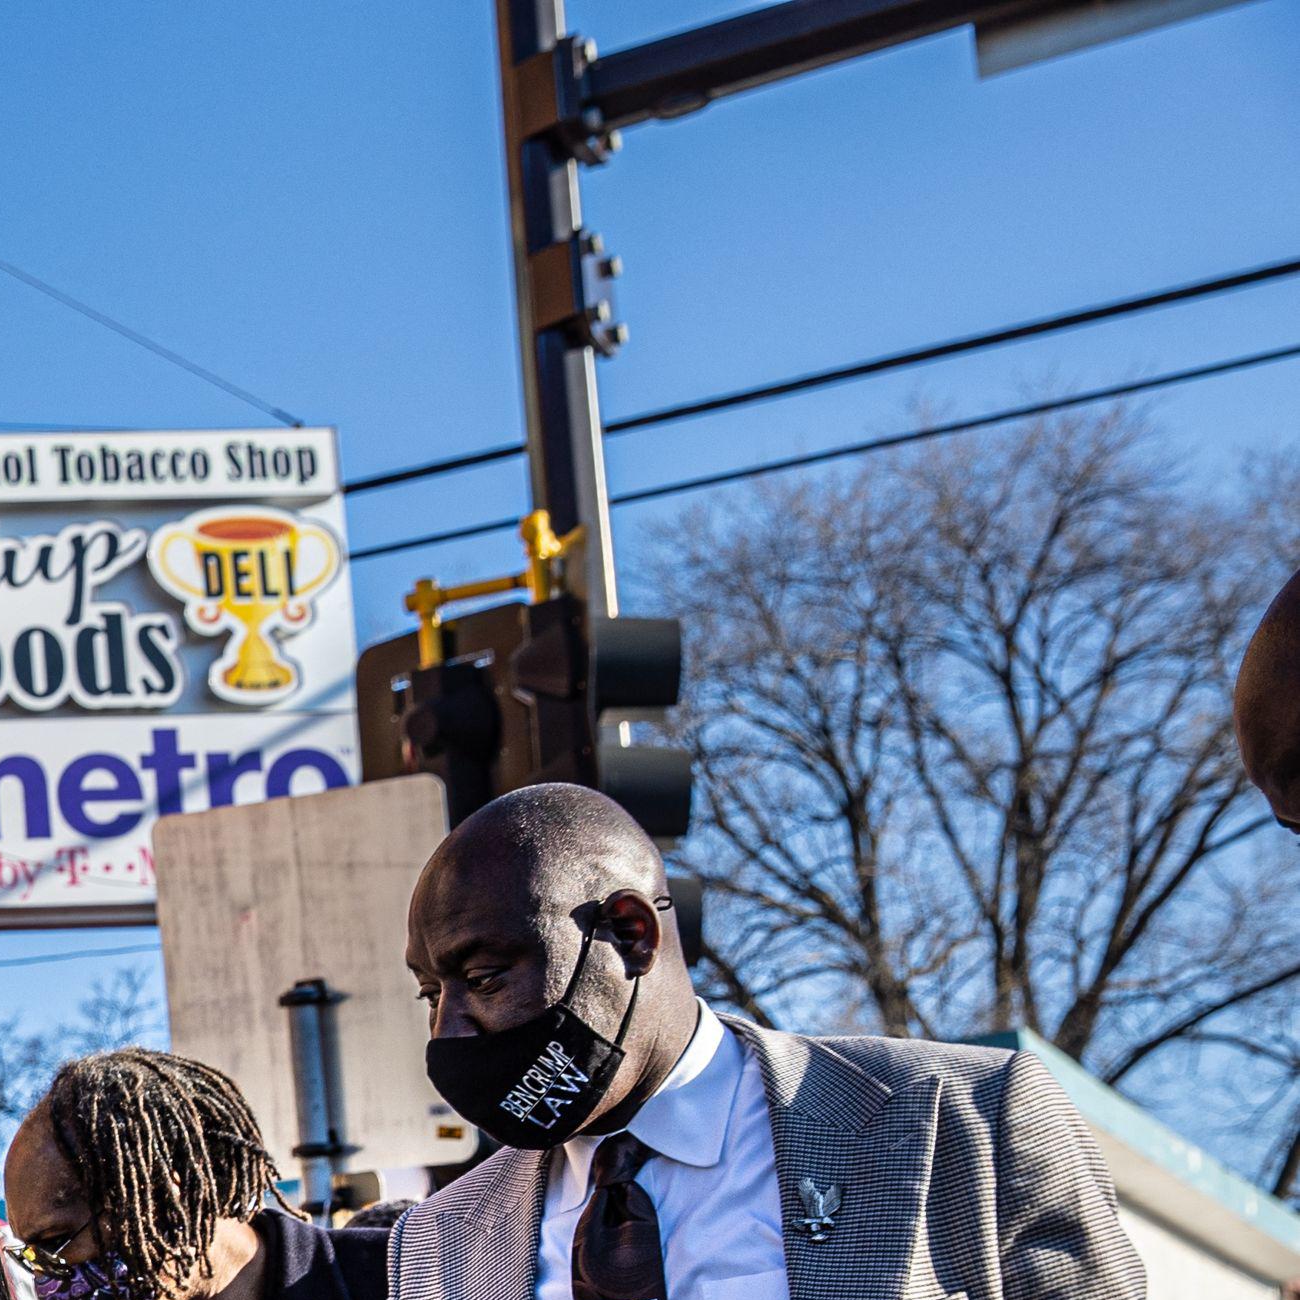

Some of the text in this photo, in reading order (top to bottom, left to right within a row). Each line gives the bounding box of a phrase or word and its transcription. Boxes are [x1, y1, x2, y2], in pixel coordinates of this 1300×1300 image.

[51, 445, 211, 485] Tobacco
[226, 442, 319, 485] Shop
[201, 549, 296, 600] DELI
[499, 1040, 574, 1122] BEN CRUMP
[526, 1062, 591, 1130] LAW
